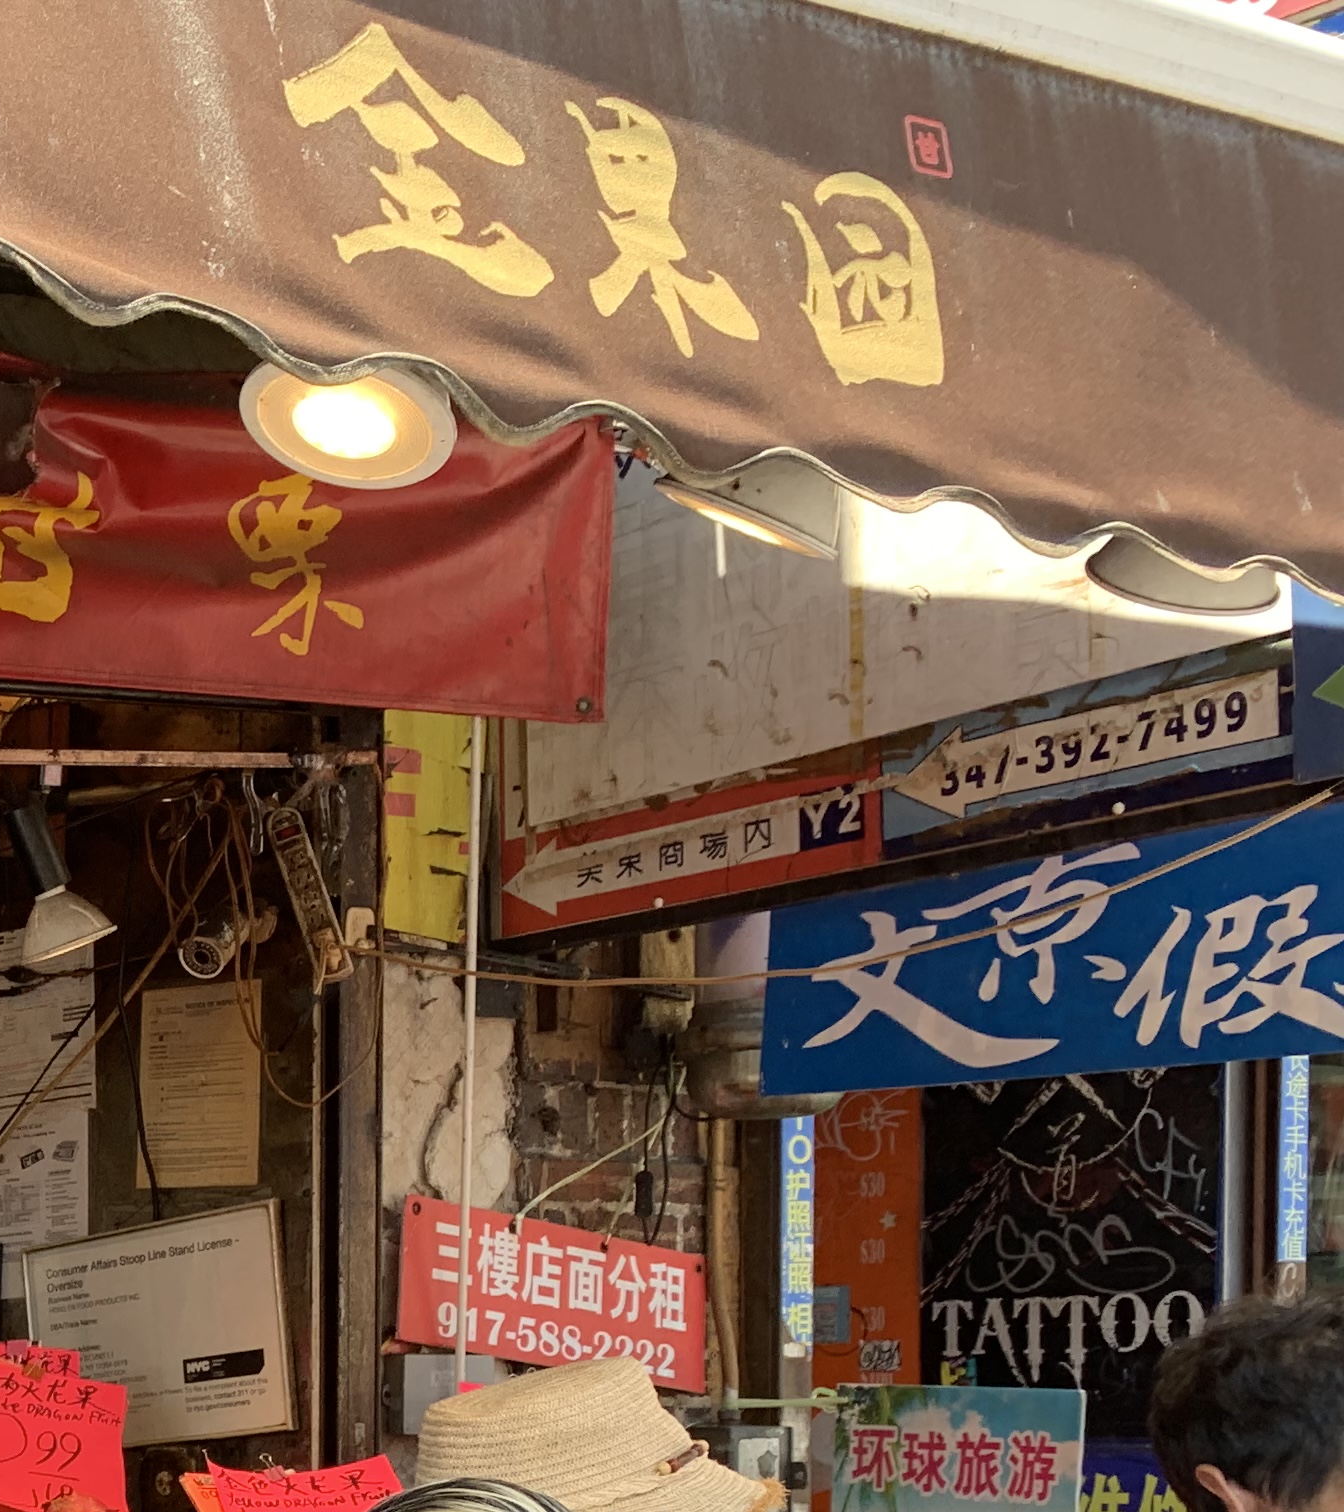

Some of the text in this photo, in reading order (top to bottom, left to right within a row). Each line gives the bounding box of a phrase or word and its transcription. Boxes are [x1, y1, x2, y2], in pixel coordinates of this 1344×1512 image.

[46, 1238, 233, 1280] Consumer Affairs Stoop Line Stand License
[932, 1290, 1210, 1387] TATTOO
[848, 1424, 1059, 1505] 环球旅游
